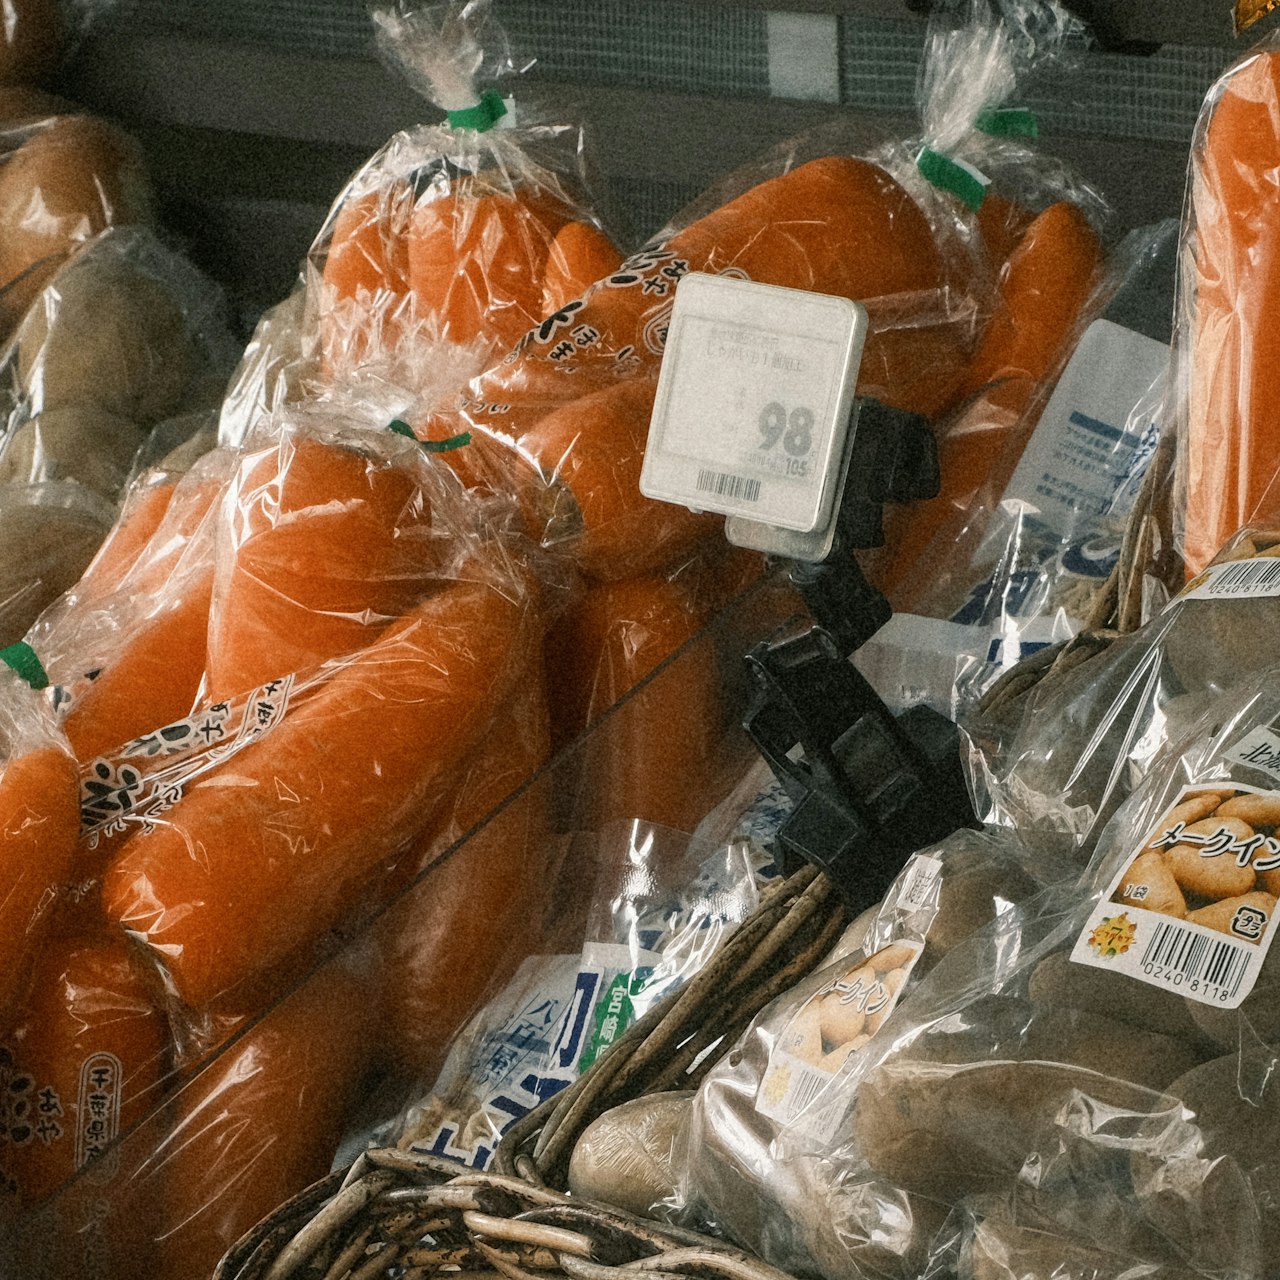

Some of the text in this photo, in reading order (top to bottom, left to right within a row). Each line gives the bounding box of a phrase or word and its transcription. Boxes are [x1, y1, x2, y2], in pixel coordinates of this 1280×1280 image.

[759, 402, 815, 457] 98
[786, 457, 808, 478] 105
[1209, 583, 1274, 595] 0240 8118
[1123, 883, 1149, 899] 1袋
[1143, 960, 1230, 1002] 0240 8118
